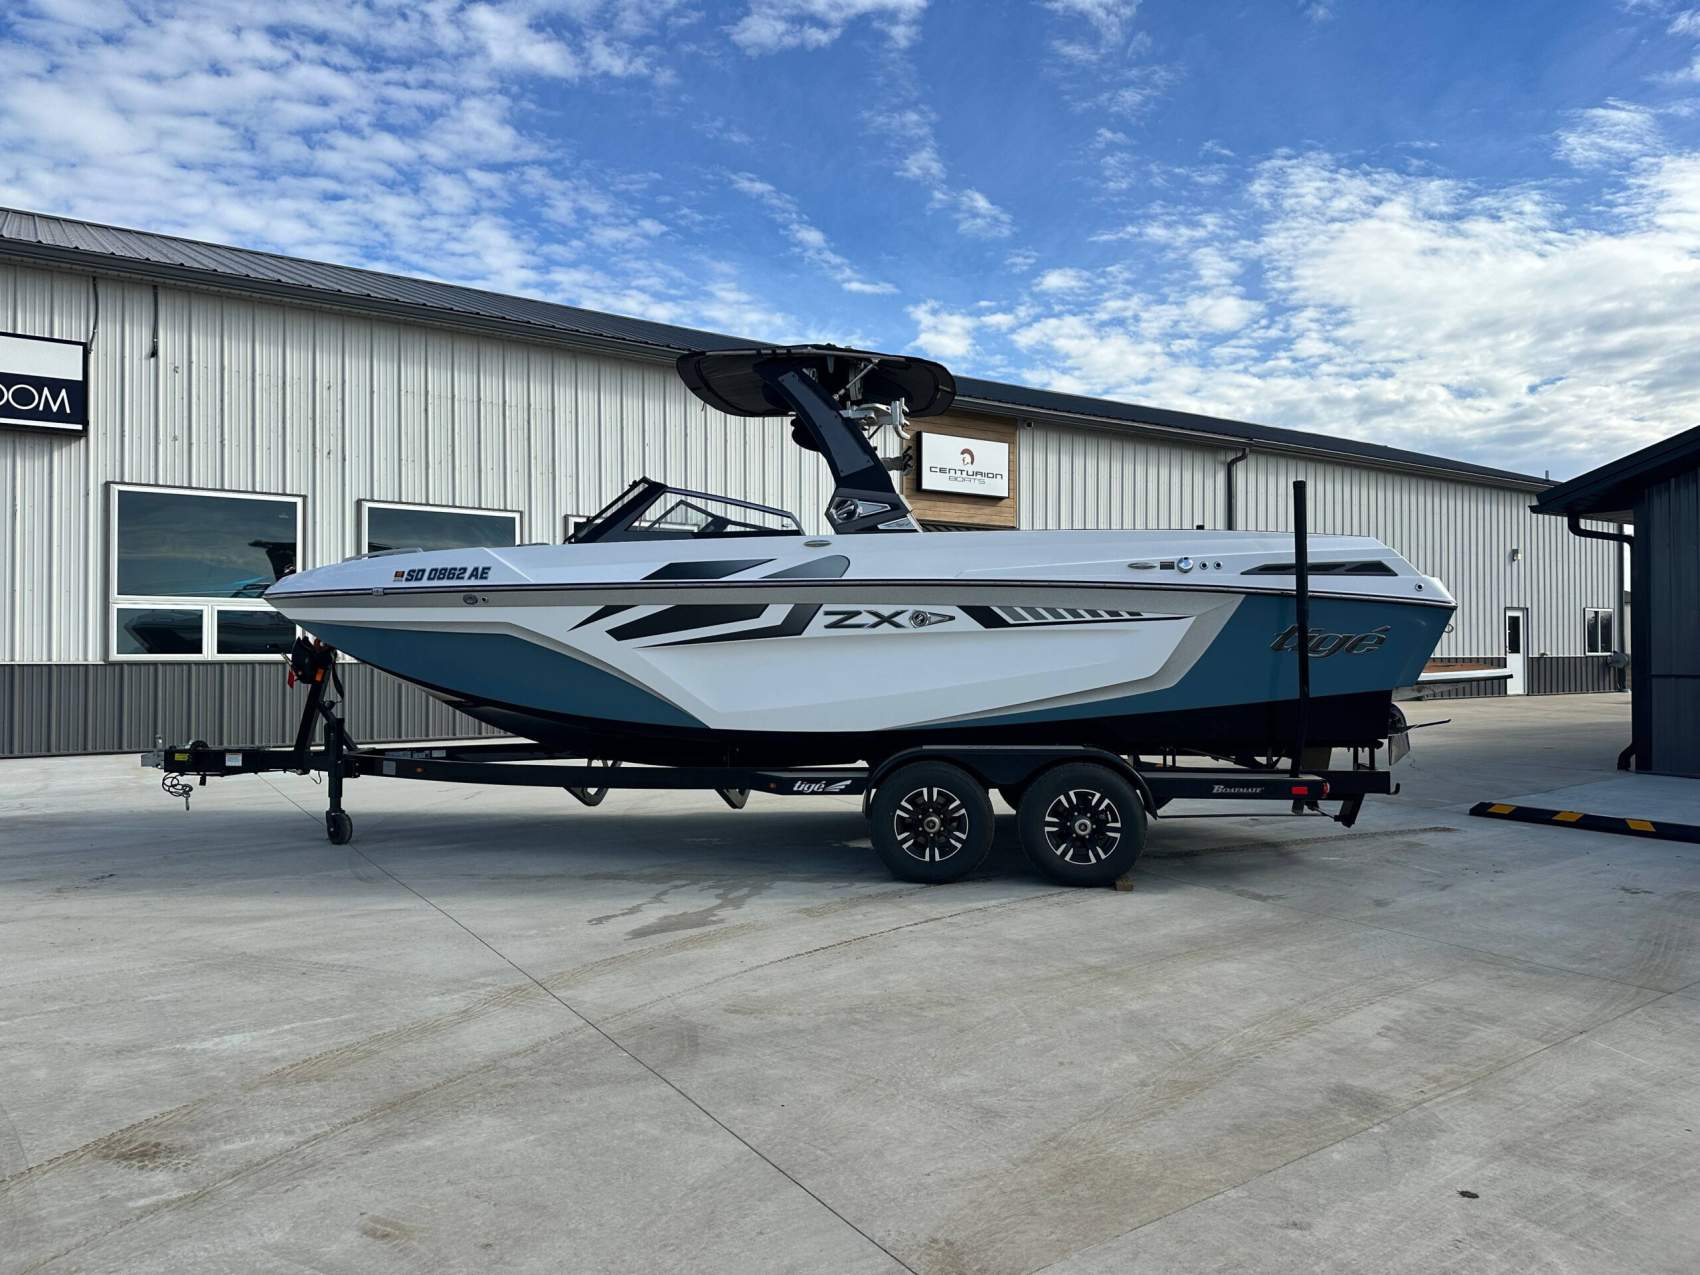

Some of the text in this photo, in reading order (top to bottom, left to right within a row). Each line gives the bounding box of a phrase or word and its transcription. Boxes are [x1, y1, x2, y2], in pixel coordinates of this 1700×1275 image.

[0, 384, 71, 413] OM
[929, 466, 1004, 480] CENTURION
[948, 475, 985, 485] BOATS
[405, 566, 491, 582] SD 0862 AE
[823, 609, 908, 629] ZX
[793, 780, 826, 793] tigé
